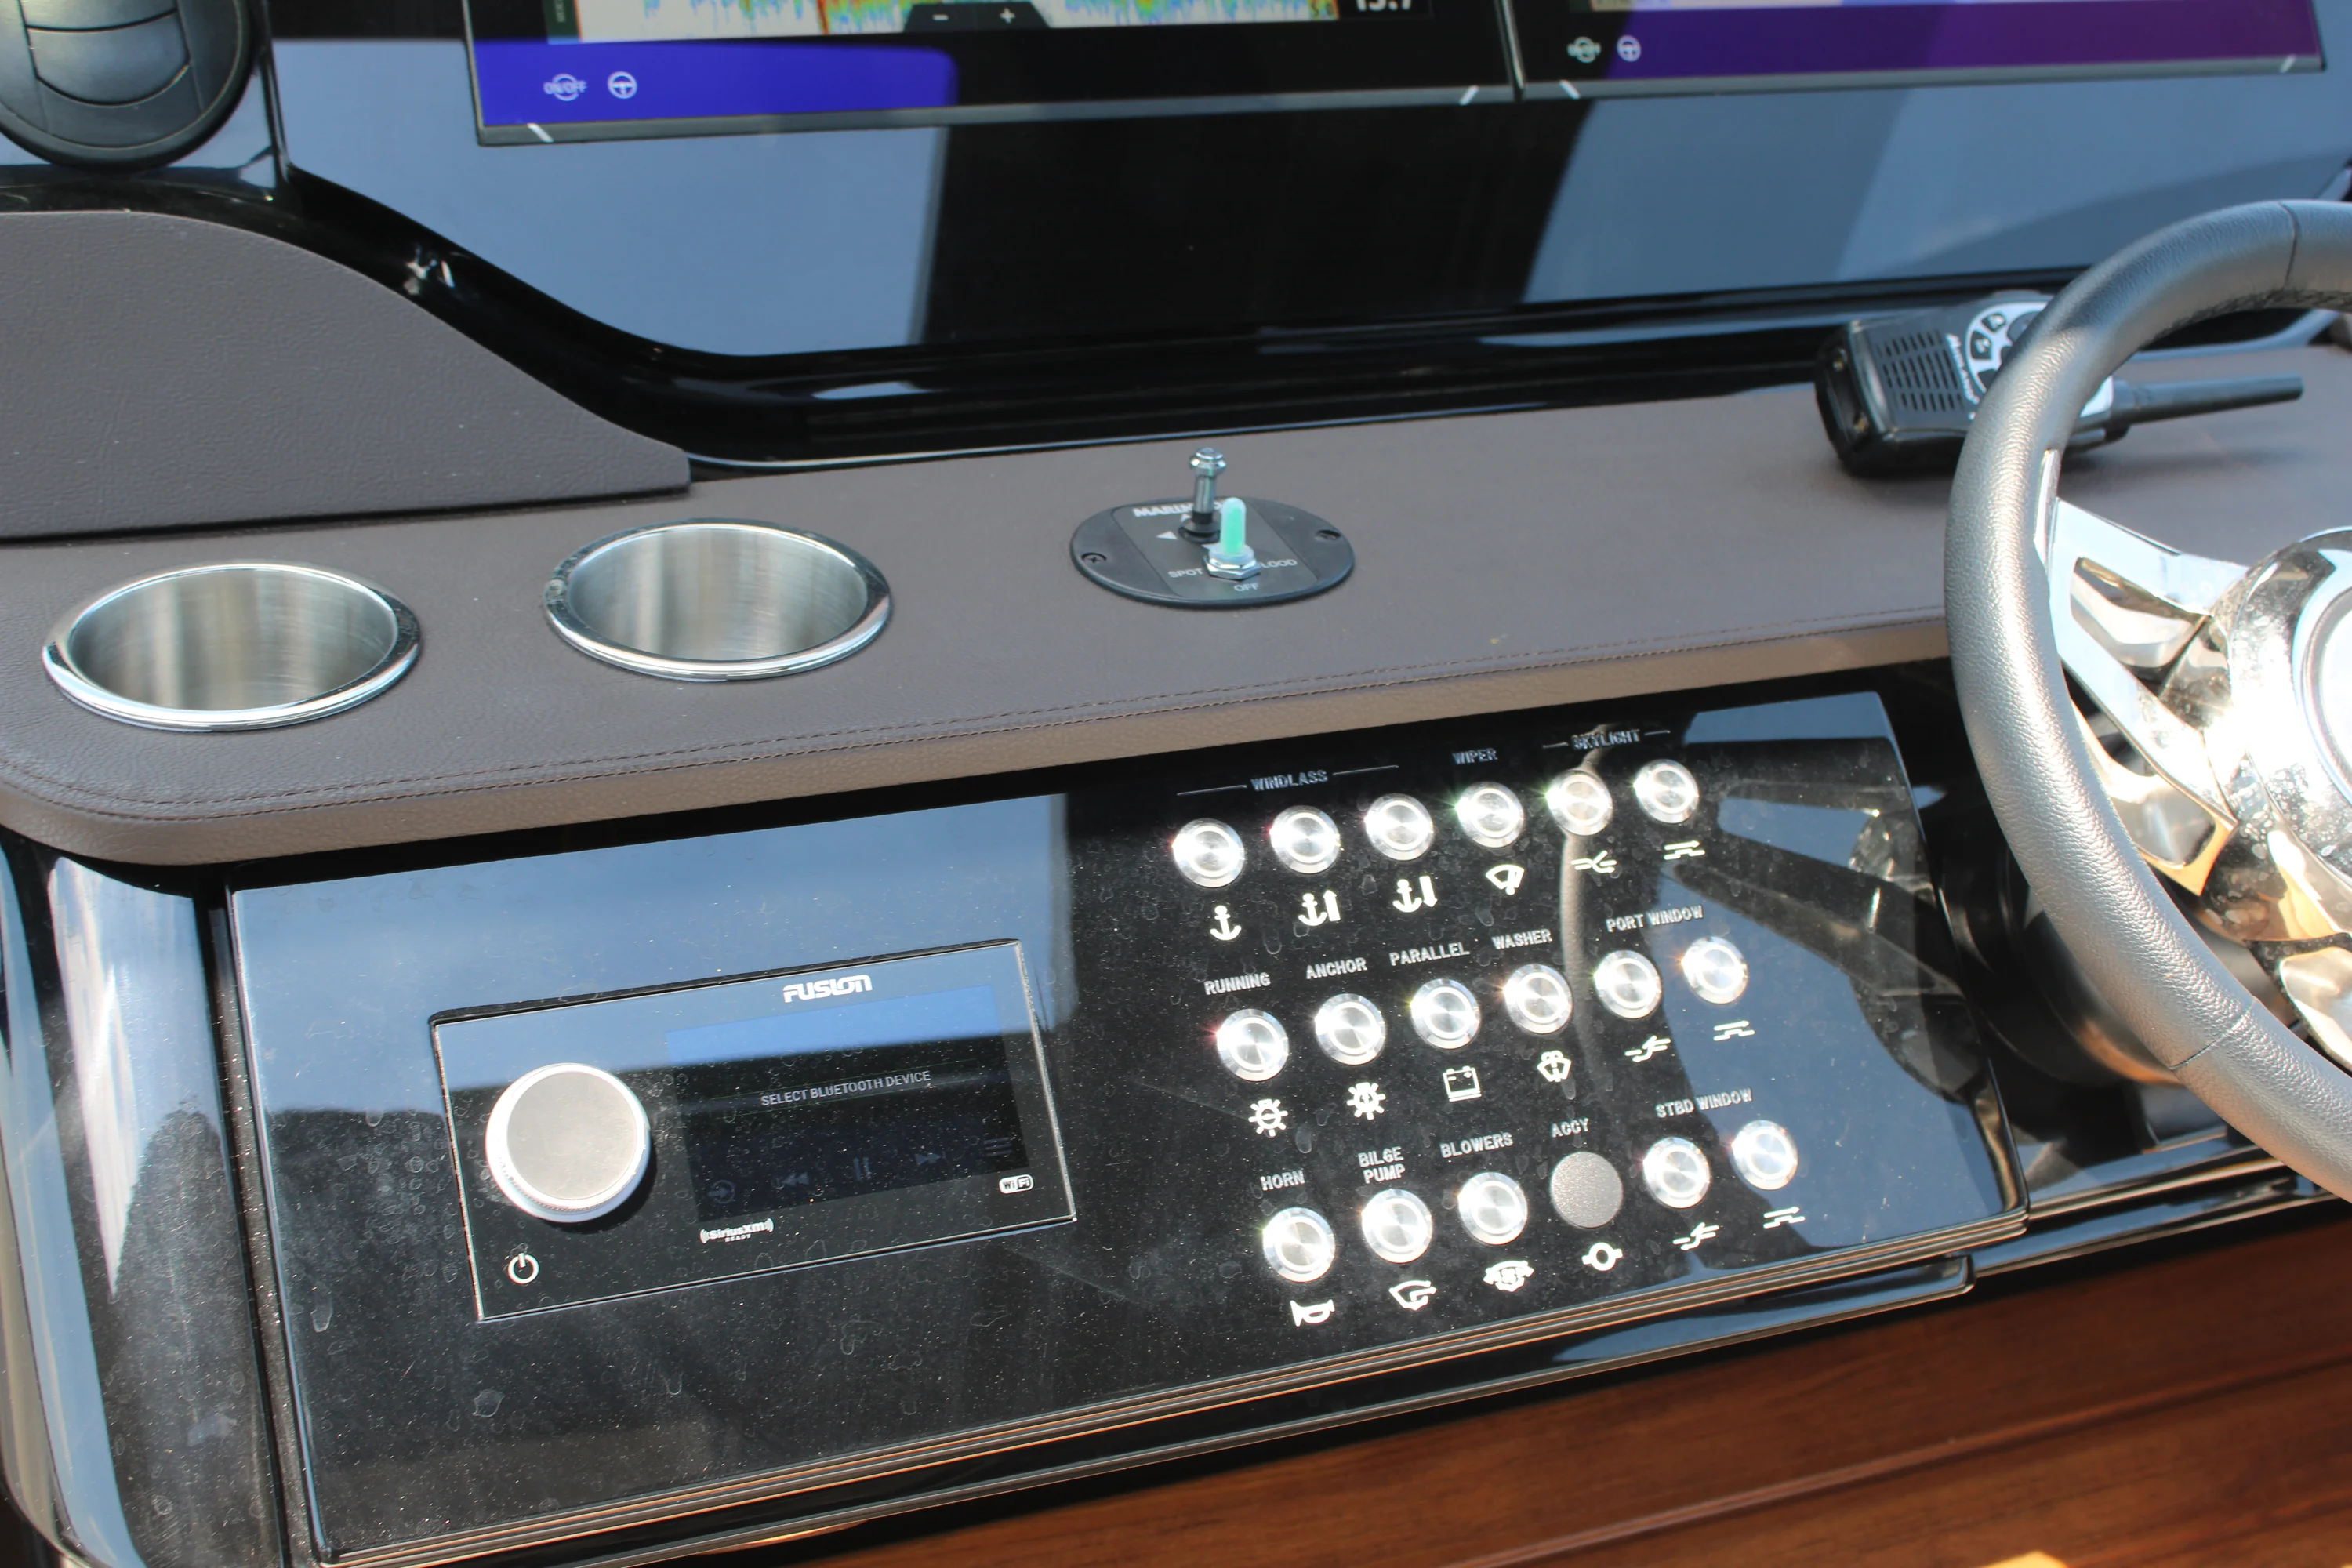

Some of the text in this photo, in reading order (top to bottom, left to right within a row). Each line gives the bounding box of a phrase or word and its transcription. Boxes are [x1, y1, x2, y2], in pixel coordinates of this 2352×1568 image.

[1168, 568, 1203, 578] SPOT
[1260, 559, 1298, 569] LOOD
[1233, 583, 1259, 592] OFF
[1572, 729, 1640, 750] SKYLIGHT
[1452, 748, 1498, 765] WIPER
[1251, 770, 1328, 791] WINDLASS
[1606, 905, 1704, 933] PORT WINDOW
[1491, 928, 1552, 949] WASHER
[1388, 942, 1470, 966] PARALLEL
[1305, 956, 1368, 980] ANCHOR
[782, 975, 873, 1003] FUSION
[1203, 972, 1271, 995] RUNNING
[760, 1070, 931, 1106] SELECT BLUETOOTH DEVICE
[1655, 1087, 1753, 1119] STBD WINDOW
[1551, 1117, 1589, 1138] ACCY
[1357, 1145, 1405, 1167] BILGE
[1439, 1132, 1513, 1159] BLOWERS
[1260, 1170, 1305, 1191] HORN
[1363, 1163, 1406, 1184] PUMP
[724, 1233, 752, 1243] READY
